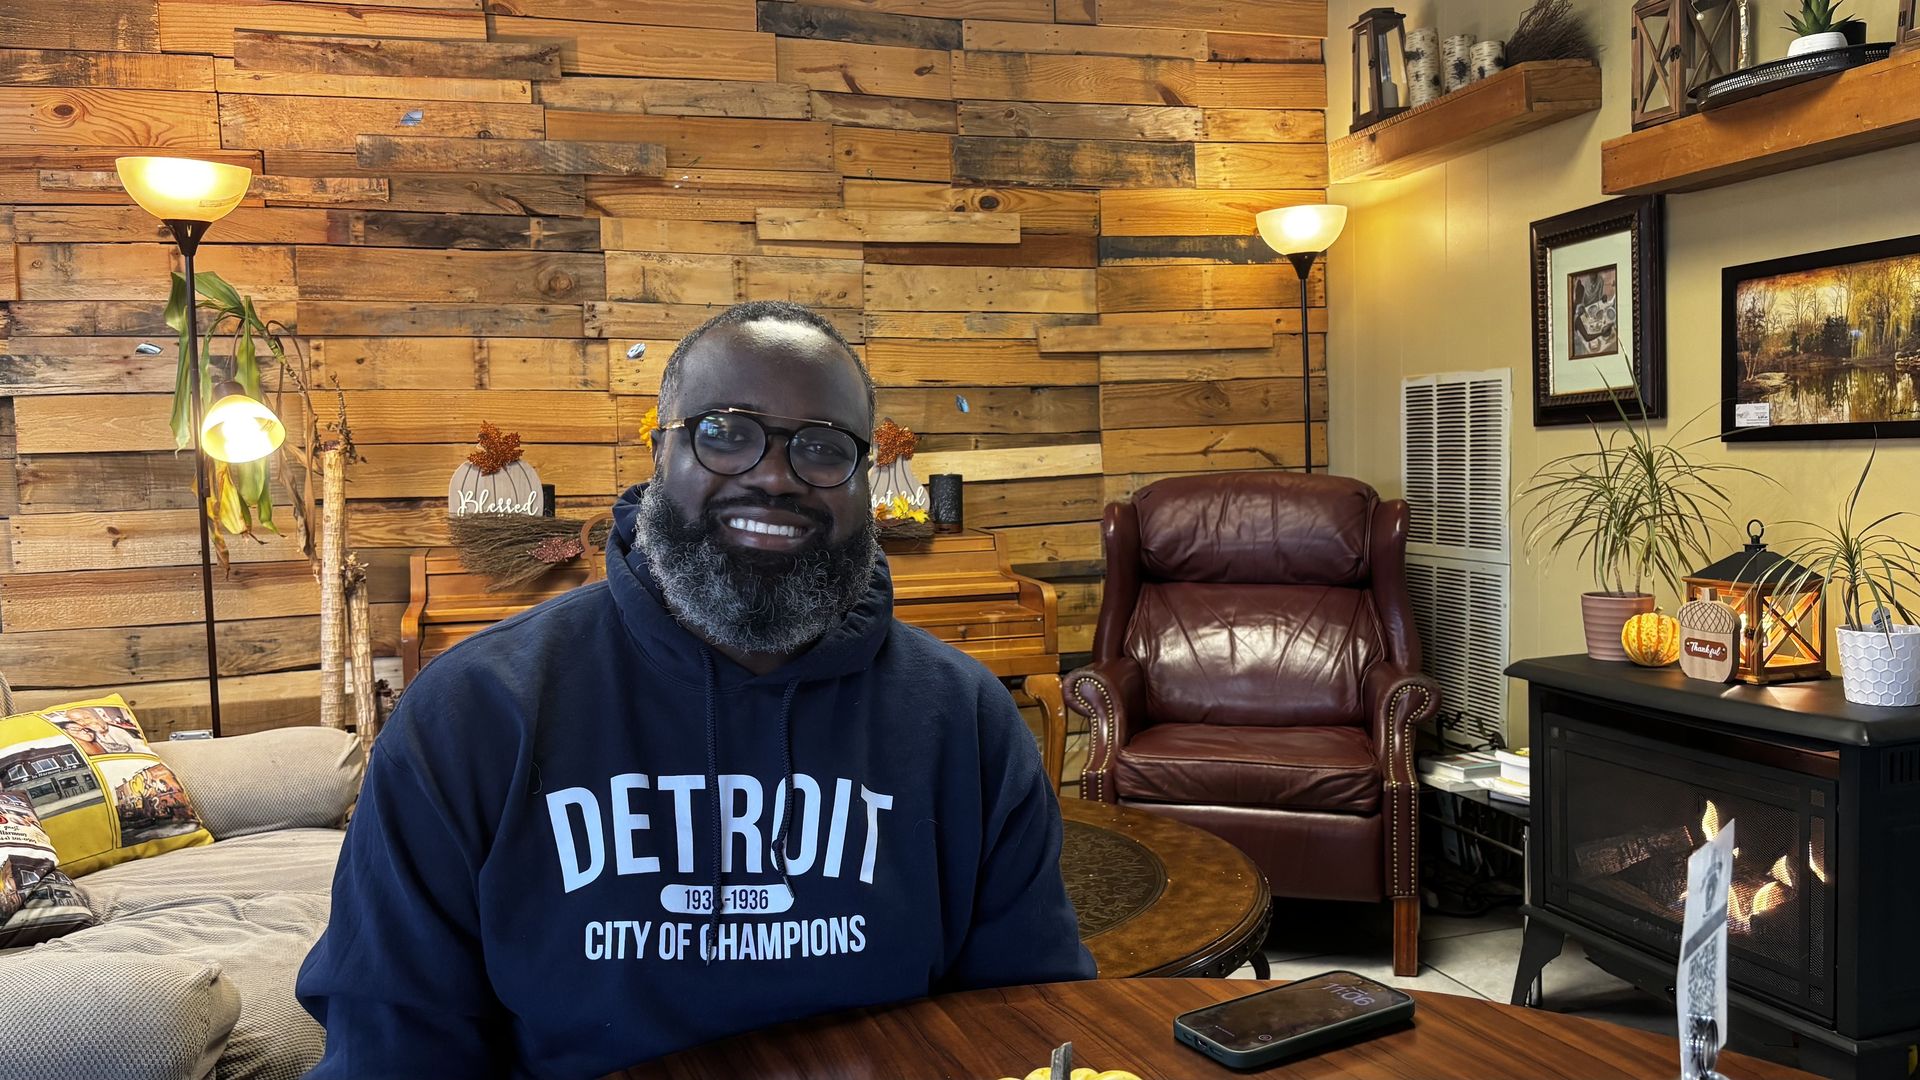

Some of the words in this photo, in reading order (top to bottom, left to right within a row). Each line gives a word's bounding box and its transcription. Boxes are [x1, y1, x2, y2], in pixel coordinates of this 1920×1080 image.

[457, 489, 539, 518] Blessed
[1690, 642, 1721, 658] Thankful
[545, 773, 893, 893] DETROIT
[684, 888, 769, 910] 193-1936
[585, 920, 652, 960] CITY
[659, 921, 693, 960] OF
[700, 914, 866, 961] CHAMPIONS
[1321, 984, 1376, 1006] 11:06
